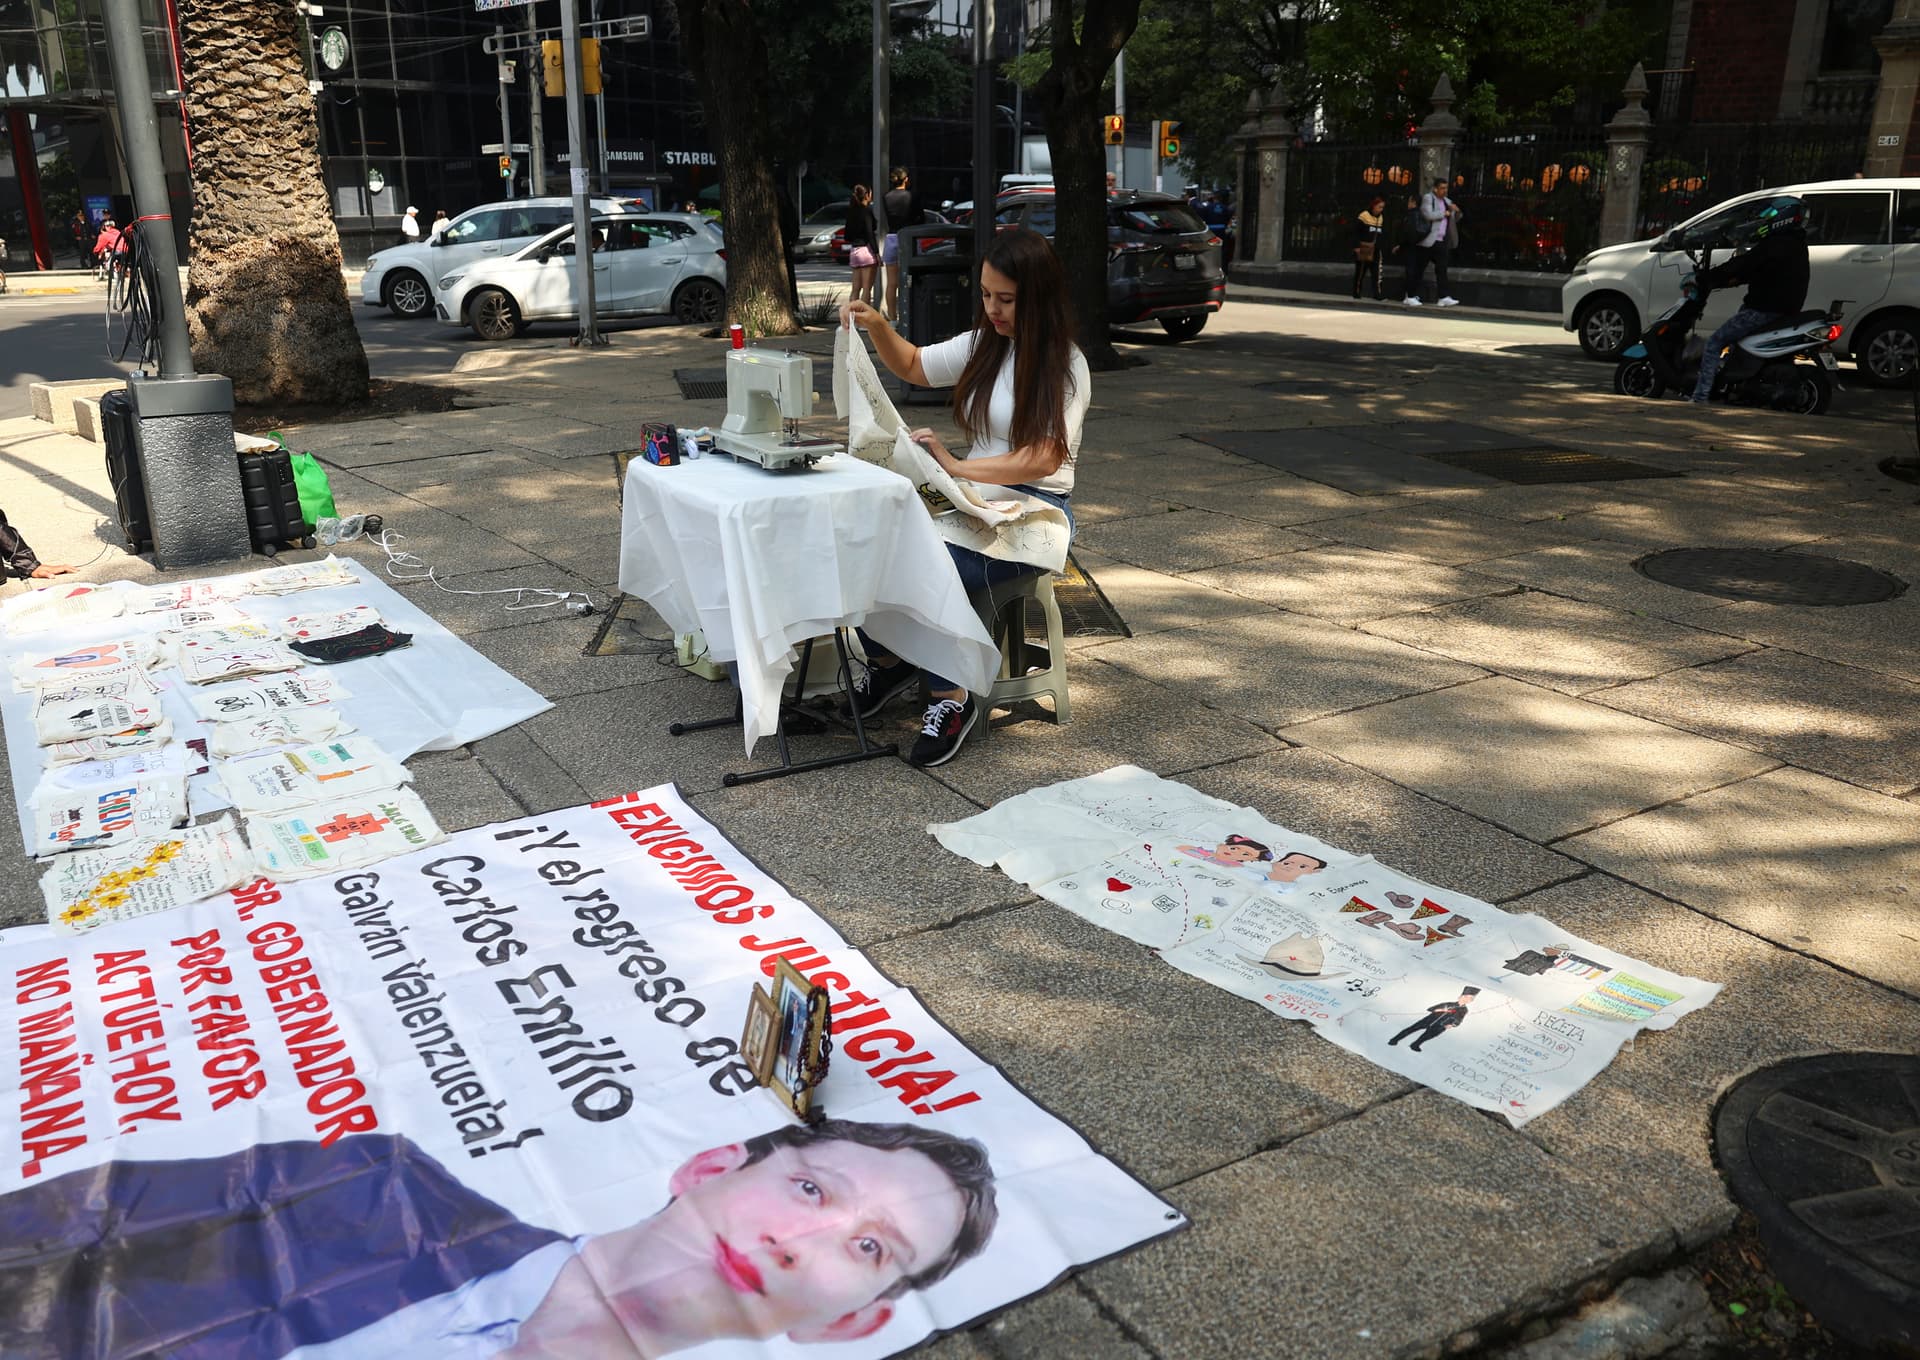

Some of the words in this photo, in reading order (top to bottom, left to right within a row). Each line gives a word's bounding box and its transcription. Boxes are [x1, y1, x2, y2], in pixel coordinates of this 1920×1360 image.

[606, 151, 644, 161] SAMSUNG
[666, 151, 717, 165] STARBU
[97, 787, 138, 833] EMILIO
[538, 859, 605, 886] el
[1308, 891, 1326, 899] Te
[230, 877, 280, 921] SR.
[16, 957, 71, 1005] NO
[170, 928, 234, 995] POR
[562, 889, 706, 1028] regreso
[94, 949, 173, 1053] ACTÚE
[421, 855, 528, 967] Carlos
[495, 963, 635, 1122] Emilio
[1264, 994, 1330, 1019] EMILIO
[247, 921, 378, 1149] GOBERNADOR
[334, 872, 410, 960] Galván
[382, 957, 544, 1160] Valenzuela!
[739, 934, 982, 1116] JUSTICIA!
[1509, 1022, 1527, 1034] de
[1533, 1032, 1574, 1054] amor
[1533, 1010, 1586, 1042] RECETA
[189, 994, 267, 1111] FAVOR
[686, 1036, 760, 1097] de
[1448, 1060, 1488, 1083] TODO
[19, 1003, 95, 1178] MAÑANA.
